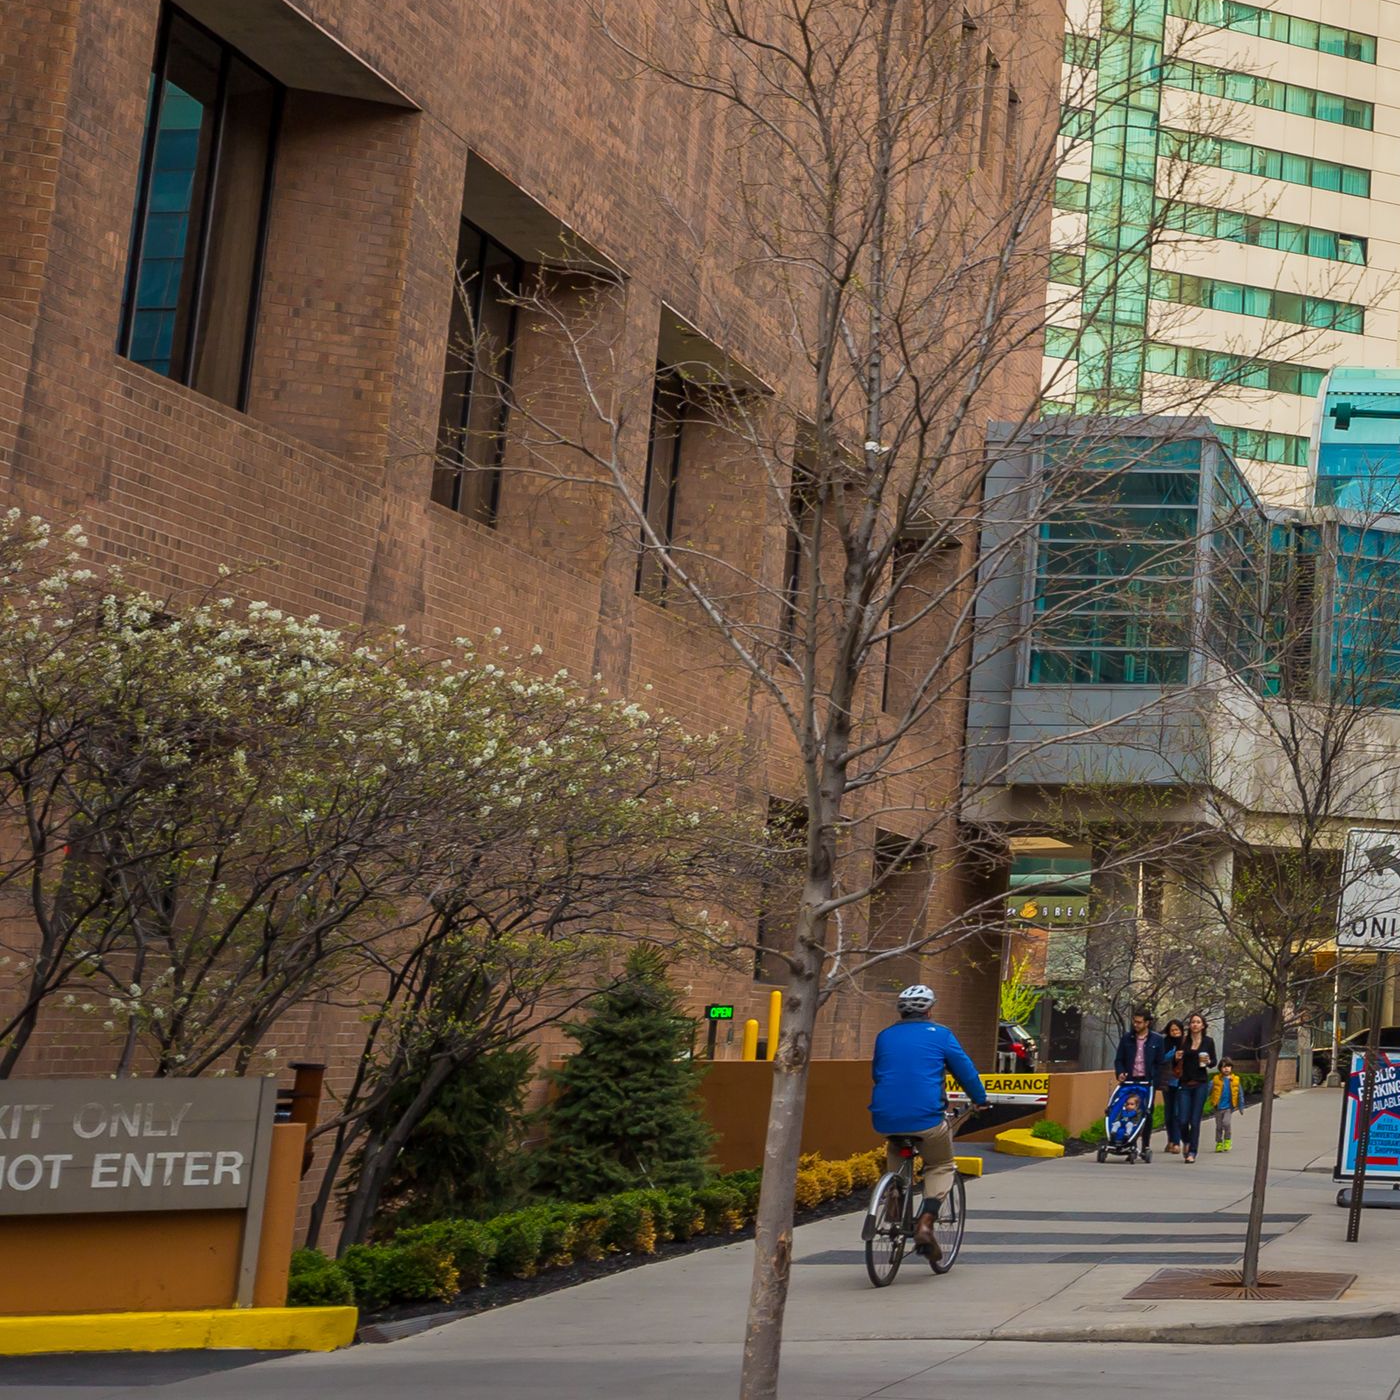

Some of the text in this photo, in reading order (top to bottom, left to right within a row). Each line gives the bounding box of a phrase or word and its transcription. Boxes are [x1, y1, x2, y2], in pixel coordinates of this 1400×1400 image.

[711, 1007, 732, 1018] OPEN
[985, 1079, 1049, 1090] EARANCE
[1358, 1066, 1396, 1086] PBLIC
[72, 1102, 193, 1139] ONLY
[0, 1150, 244, 1191] OT ENTER
